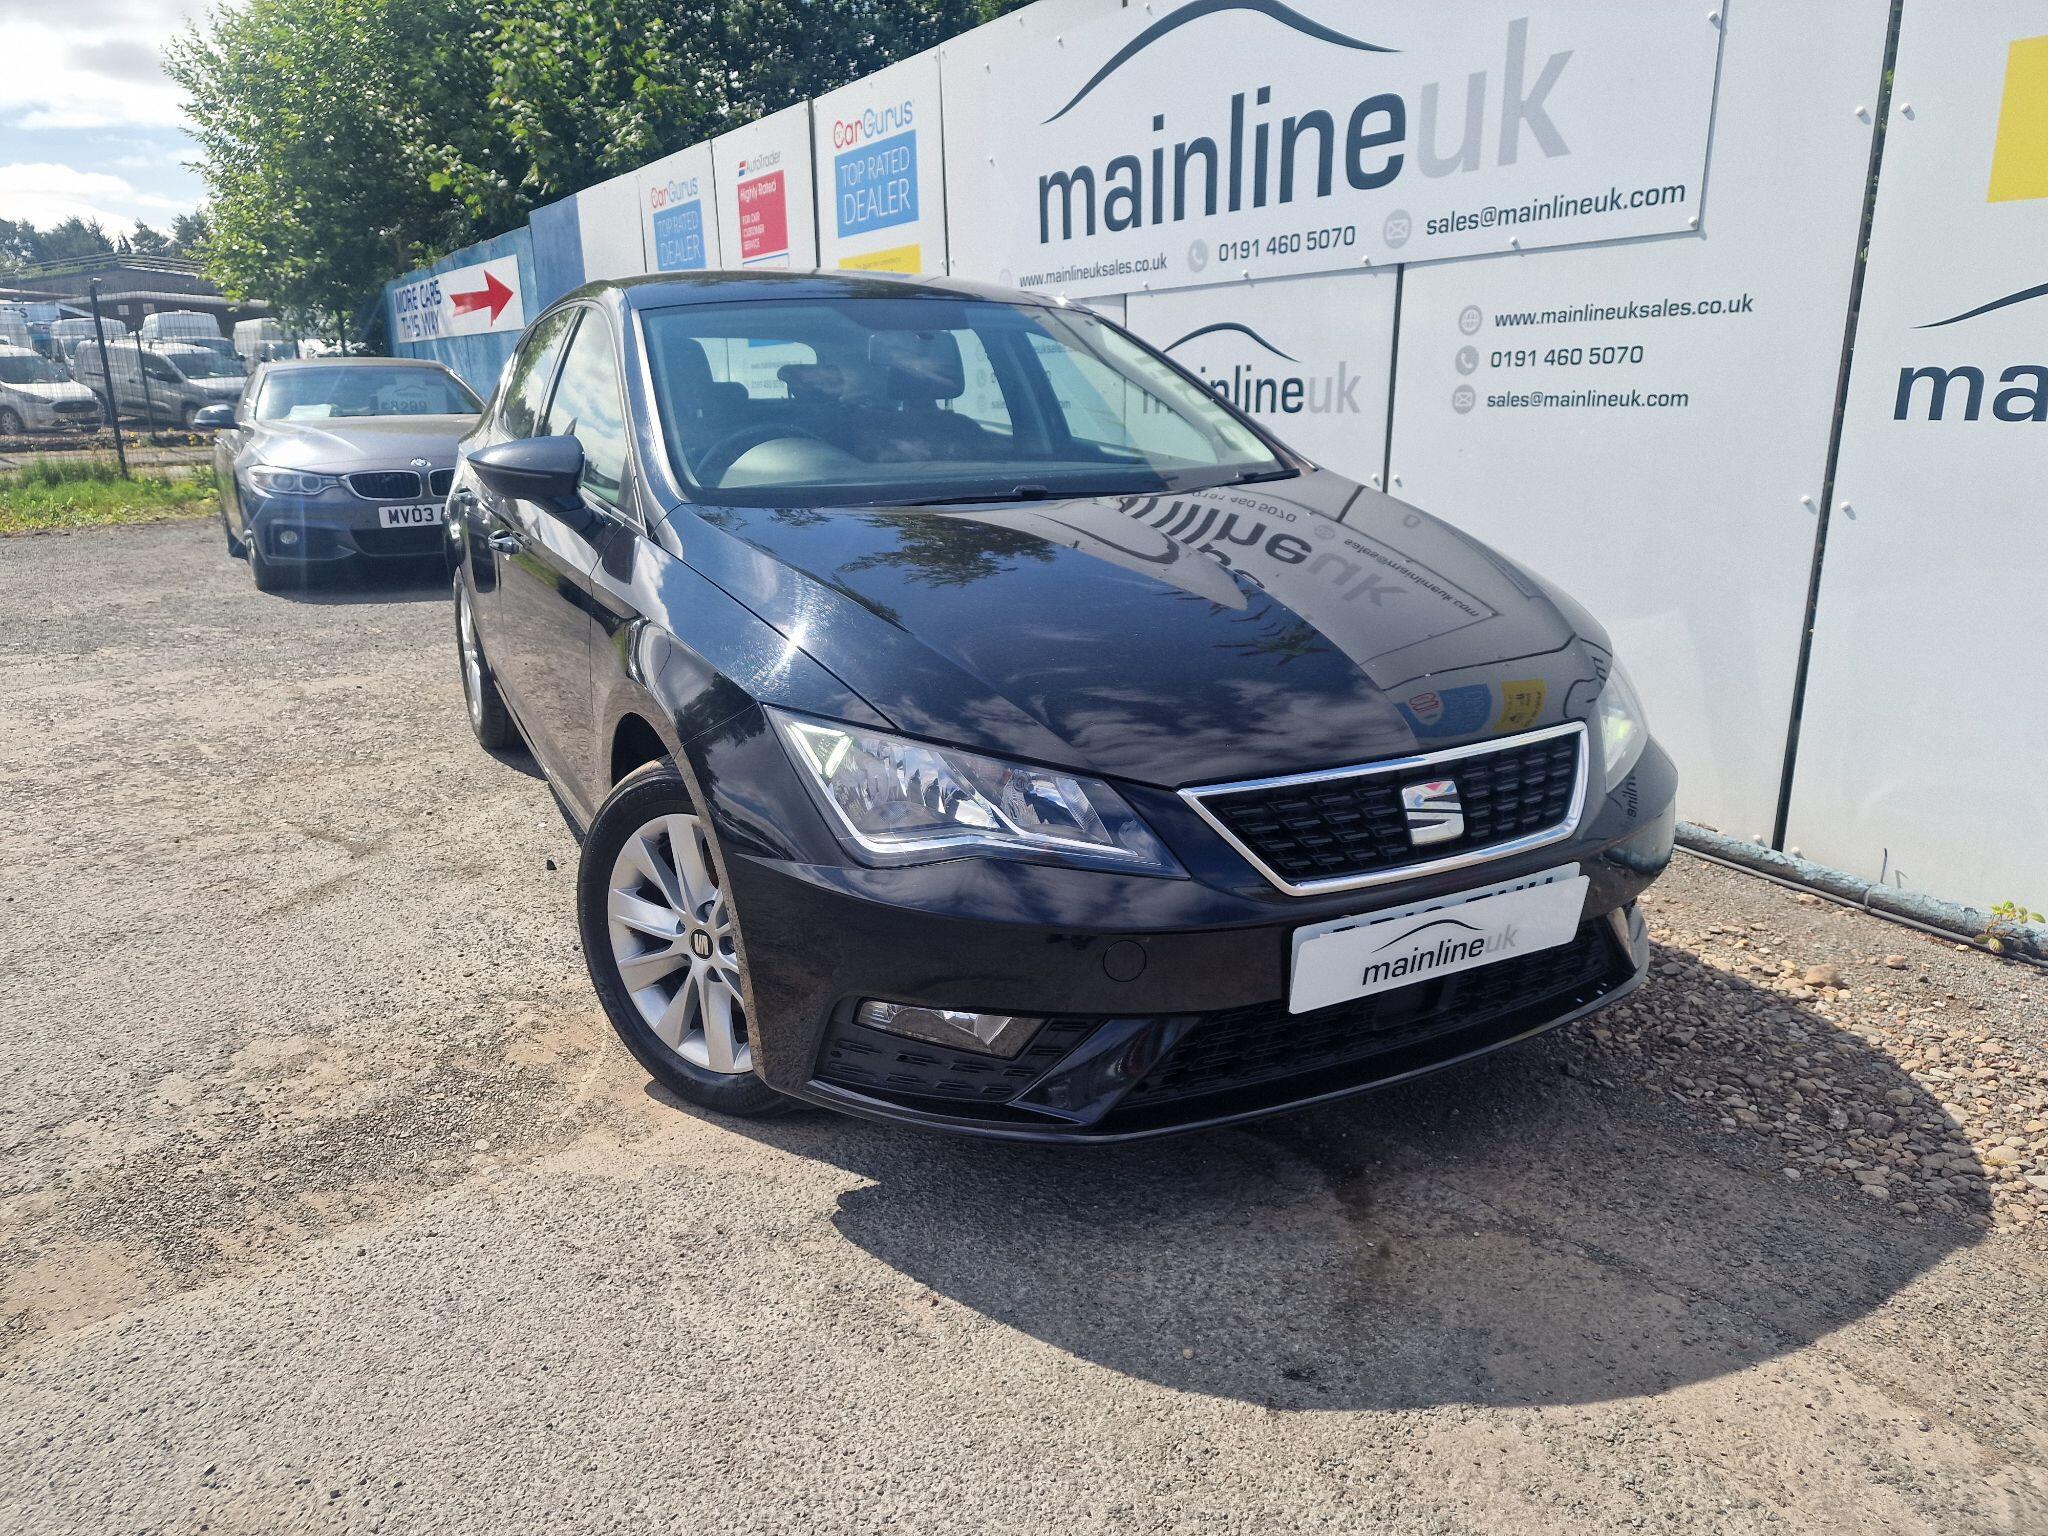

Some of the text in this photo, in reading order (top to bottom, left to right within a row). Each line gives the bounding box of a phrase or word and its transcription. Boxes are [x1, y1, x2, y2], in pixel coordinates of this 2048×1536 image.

[833, 100, 913, 149] CarGurus
[1038, 17, 1574, 244] mainlineuk
[841, 146, 910, 187] TOP RATED
[651, 177, 698, 208] CarGurus
[844, 178, 911, 226] DEALER
[1426, 184, 1686, 235] sales@mainlineuk.com
[660, 234, 701, 267] DEALER
[1219, 225, 1356, 262] 0191 460 5070
[1019, 252, 1168, 287] www.mainlineuksales.co.uk
[395, 279, 442, 313] MORE CARS
[1495, 293, 1754, 327] www.mainlineuksales.co.uk
[422, 309, 440, 336] WAY
[1491, 346, 1644, 368] 0191 460 5070
[1487, 389, 1689, 408] sales@mainlineuk.com
[388, 507, 434, 525] MV03
[1361, 923, 1519, 986] mainlineuk
